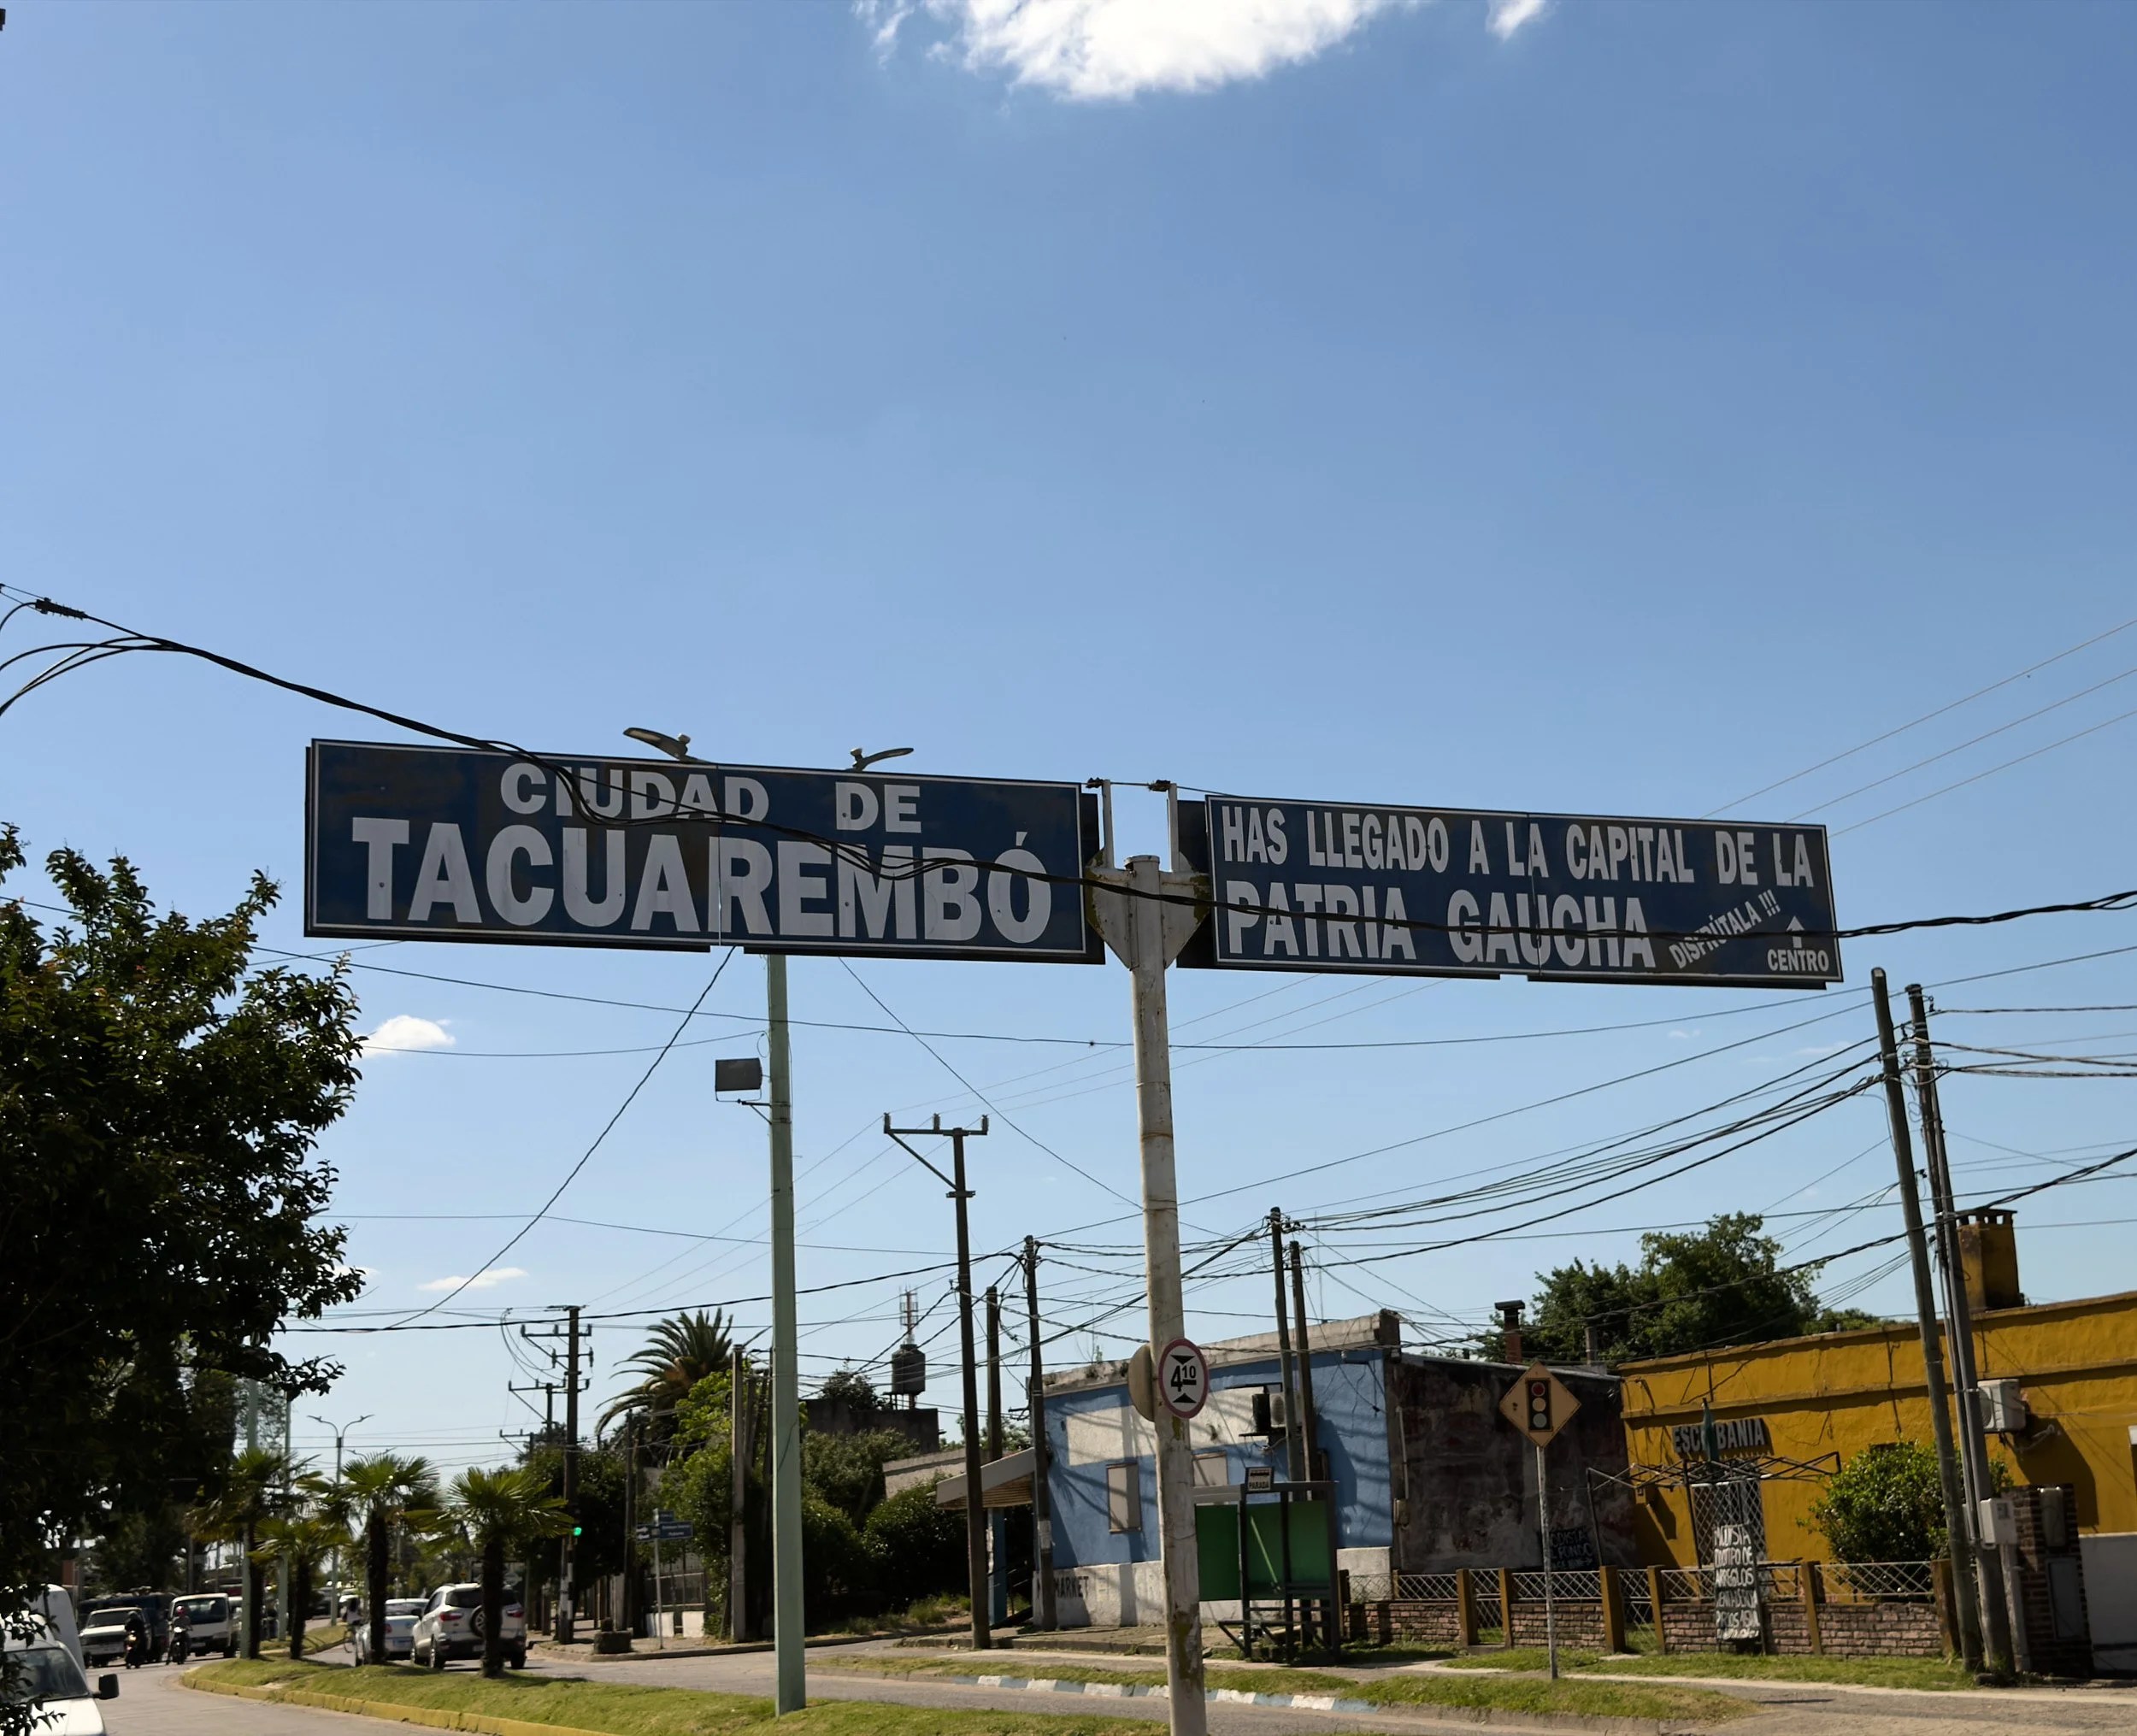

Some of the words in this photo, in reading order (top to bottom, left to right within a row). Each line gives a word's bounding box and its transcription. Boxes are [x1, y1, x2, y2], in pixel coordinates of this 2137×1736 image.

[501, 763, 769, 822] CIUDAD
[835, 781, 921, 833] DE
[351, 817, 1051, 943] TACUAREMBÓ
[1222, 805, 1286, 865] HAS
[1307, 810, 1449, 874] LLEGADO
[1469, 820, 1490, 875] A
[1505, 821, 1549, 878] LA
[1566, 824, 1694, 884] CAPITAL
[1716, 831, 1758, 886] DE
[1774, 833, 1814, 888] LA
[1227, 880, 1417, 960] PATRIA
[1447, 890, 1656, 968] GAUCHA
[1767, 949, 1829, 972] CENTRO
[1673, 1421, 1765, 1452] ESCBANIA
